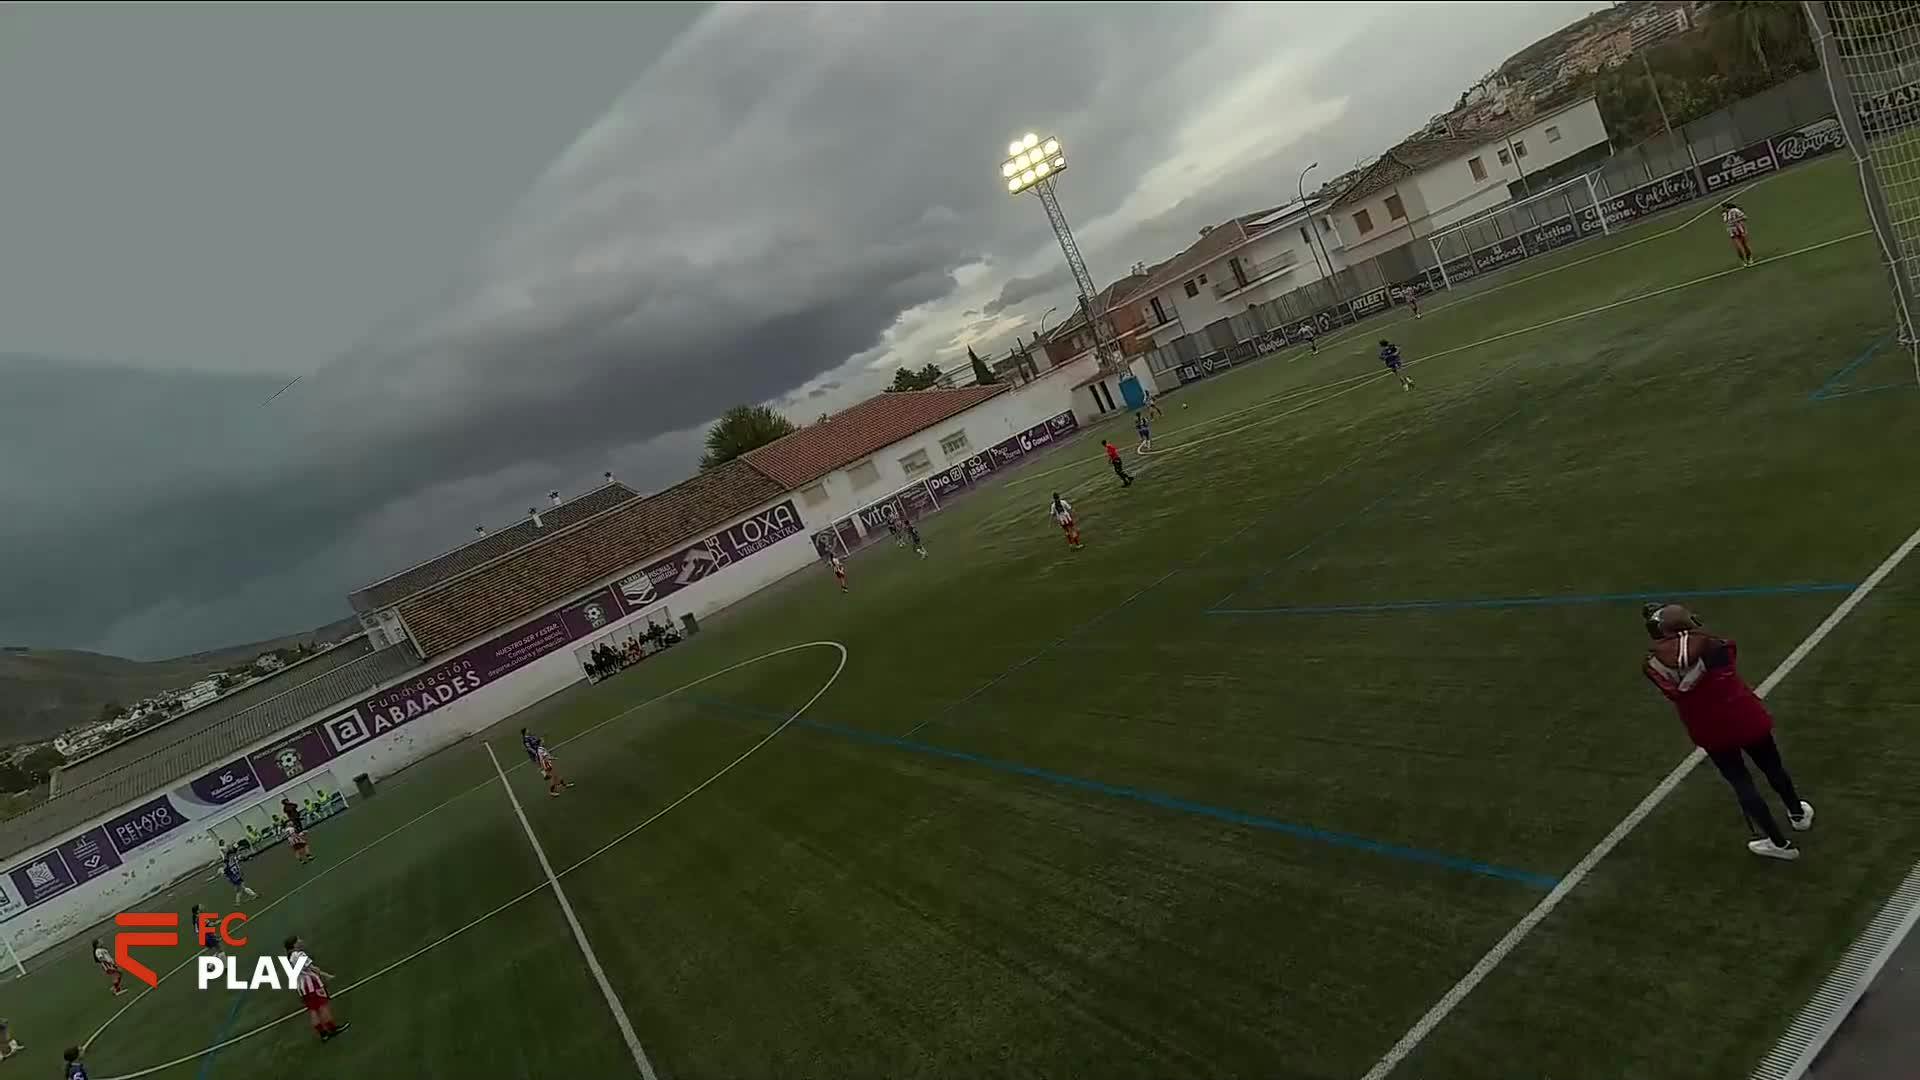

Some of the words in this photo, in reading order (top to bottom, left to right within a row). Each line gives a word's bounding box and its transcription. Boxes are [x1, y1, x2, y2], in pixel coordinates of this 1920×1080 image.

[1706, 155, 1773, 186] OTERO
[1352, 289, 1385, 311] ATLEET
[727, 505, 795, 549] LOXA
[769, 523, 799, 543] EXTRA
[495, 639, 524, 657] NUESTRO
[522, 633, 535, 645] SER
[115, 807, 168, 839] PELAYO
